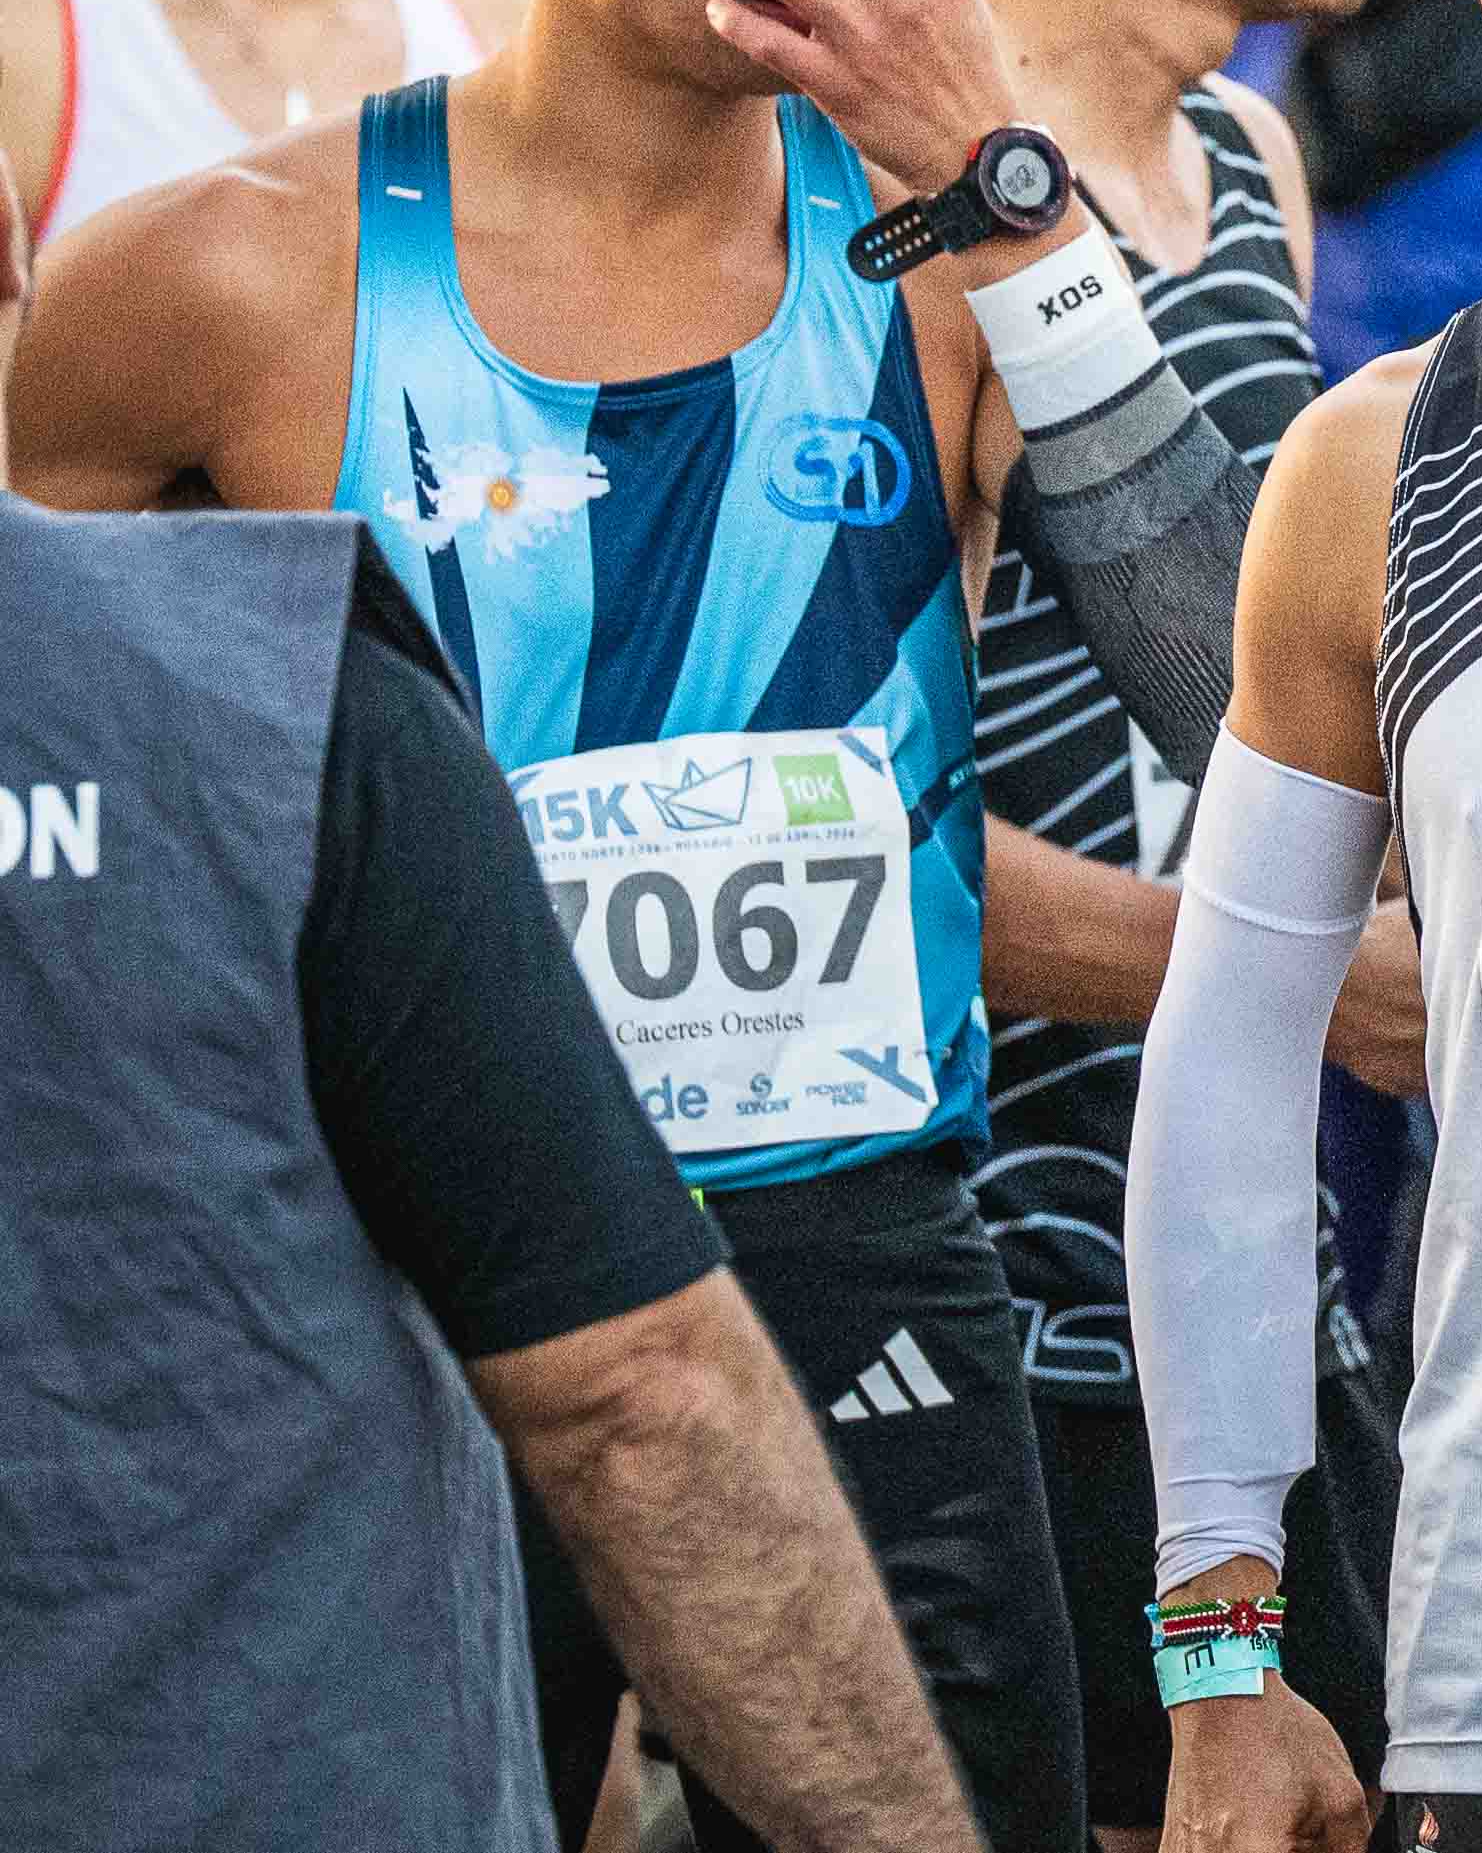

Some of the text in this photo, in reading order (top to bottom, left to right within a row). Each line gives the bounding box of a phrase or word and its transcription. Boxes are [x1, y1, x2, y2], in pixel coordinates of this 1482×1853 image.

[788, 774, 842, 803] 10K
[615, 1009, 806, 1046] Caceres Orestes
